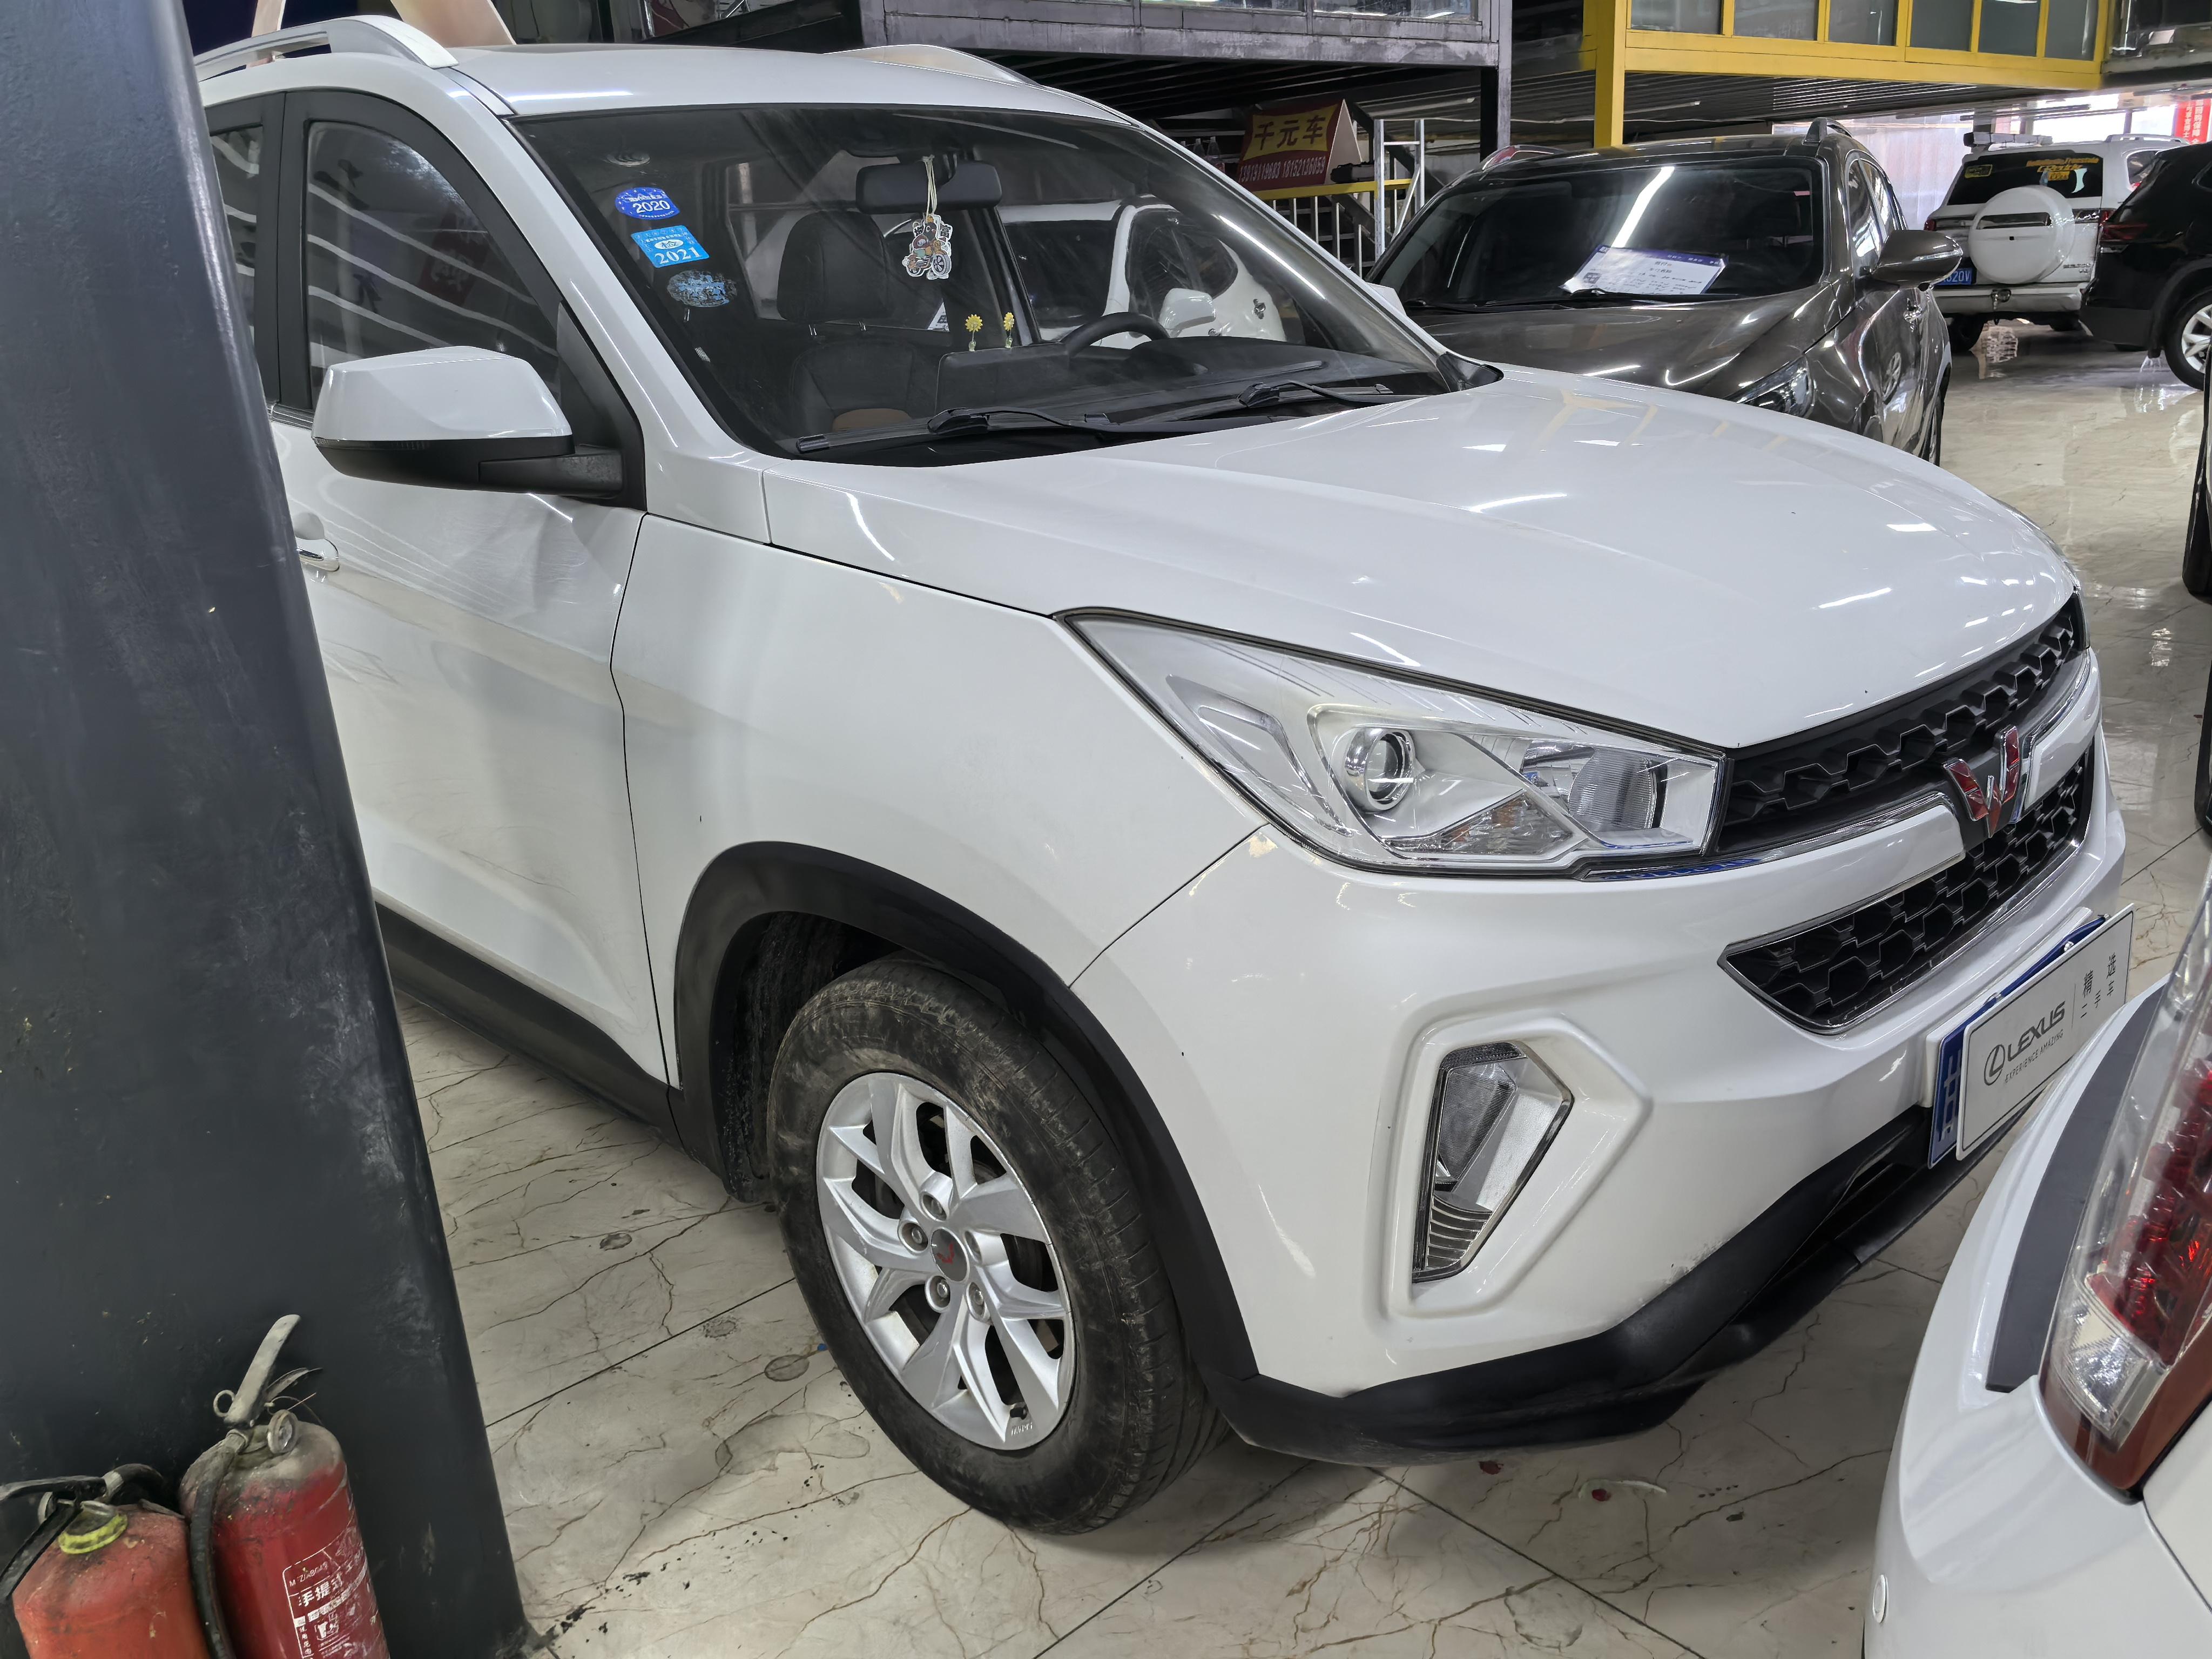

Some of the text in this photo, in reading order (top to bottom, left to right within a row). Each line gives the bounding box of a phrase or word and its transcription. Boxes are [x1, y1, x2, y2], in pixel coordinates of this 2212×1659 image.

[1255, 114, 1326, 151] 千元车
[632, 200, 671, 214] 2020
[655, 246, 702, 265] 2021
[2080, 980, 2114, 1019] 二手车
[2007, 1001, 2066, 1062] LEXUS
